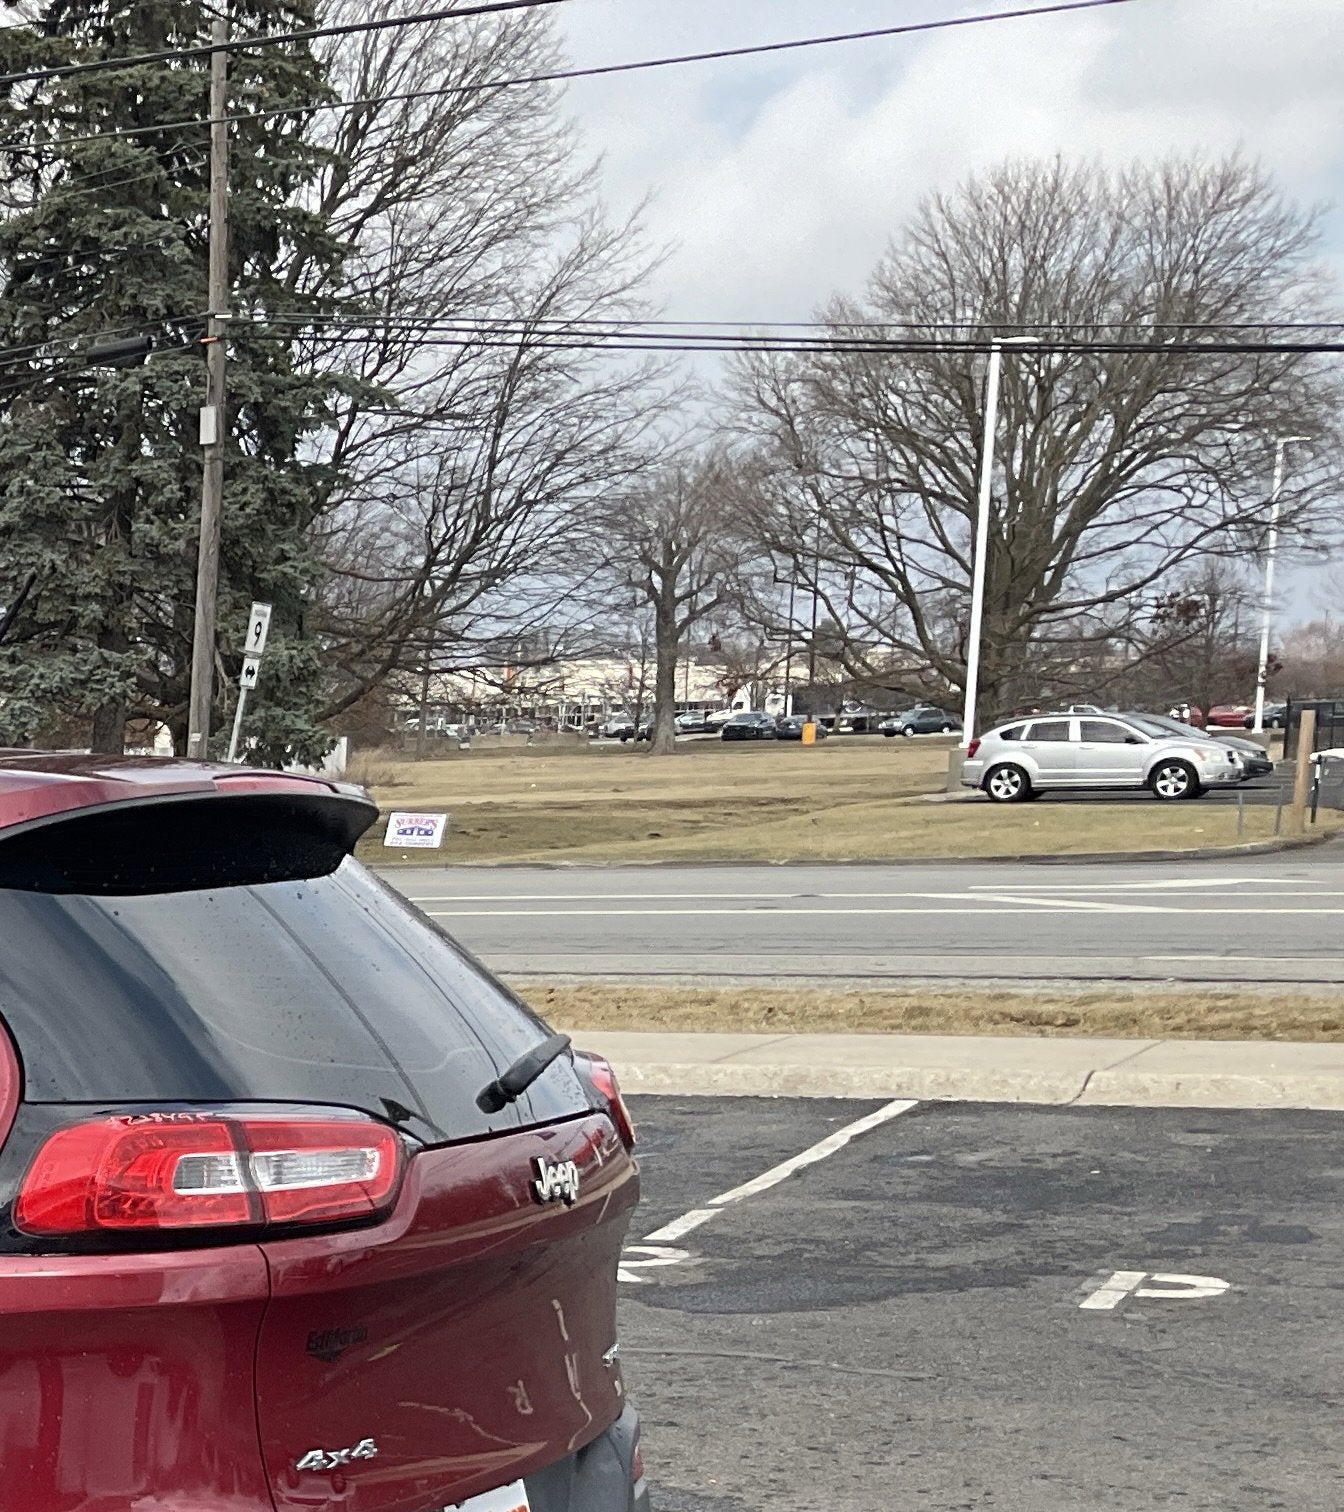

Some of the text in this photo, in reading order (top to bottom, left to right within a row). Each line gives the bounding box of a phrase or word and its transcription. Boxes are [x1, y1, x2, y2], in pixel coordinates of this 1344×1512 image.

[254, 621, 262, 647] 9
[535, 1157, 579, 1201] Jeep
[295, 1438, 379, 1471] 4x4
